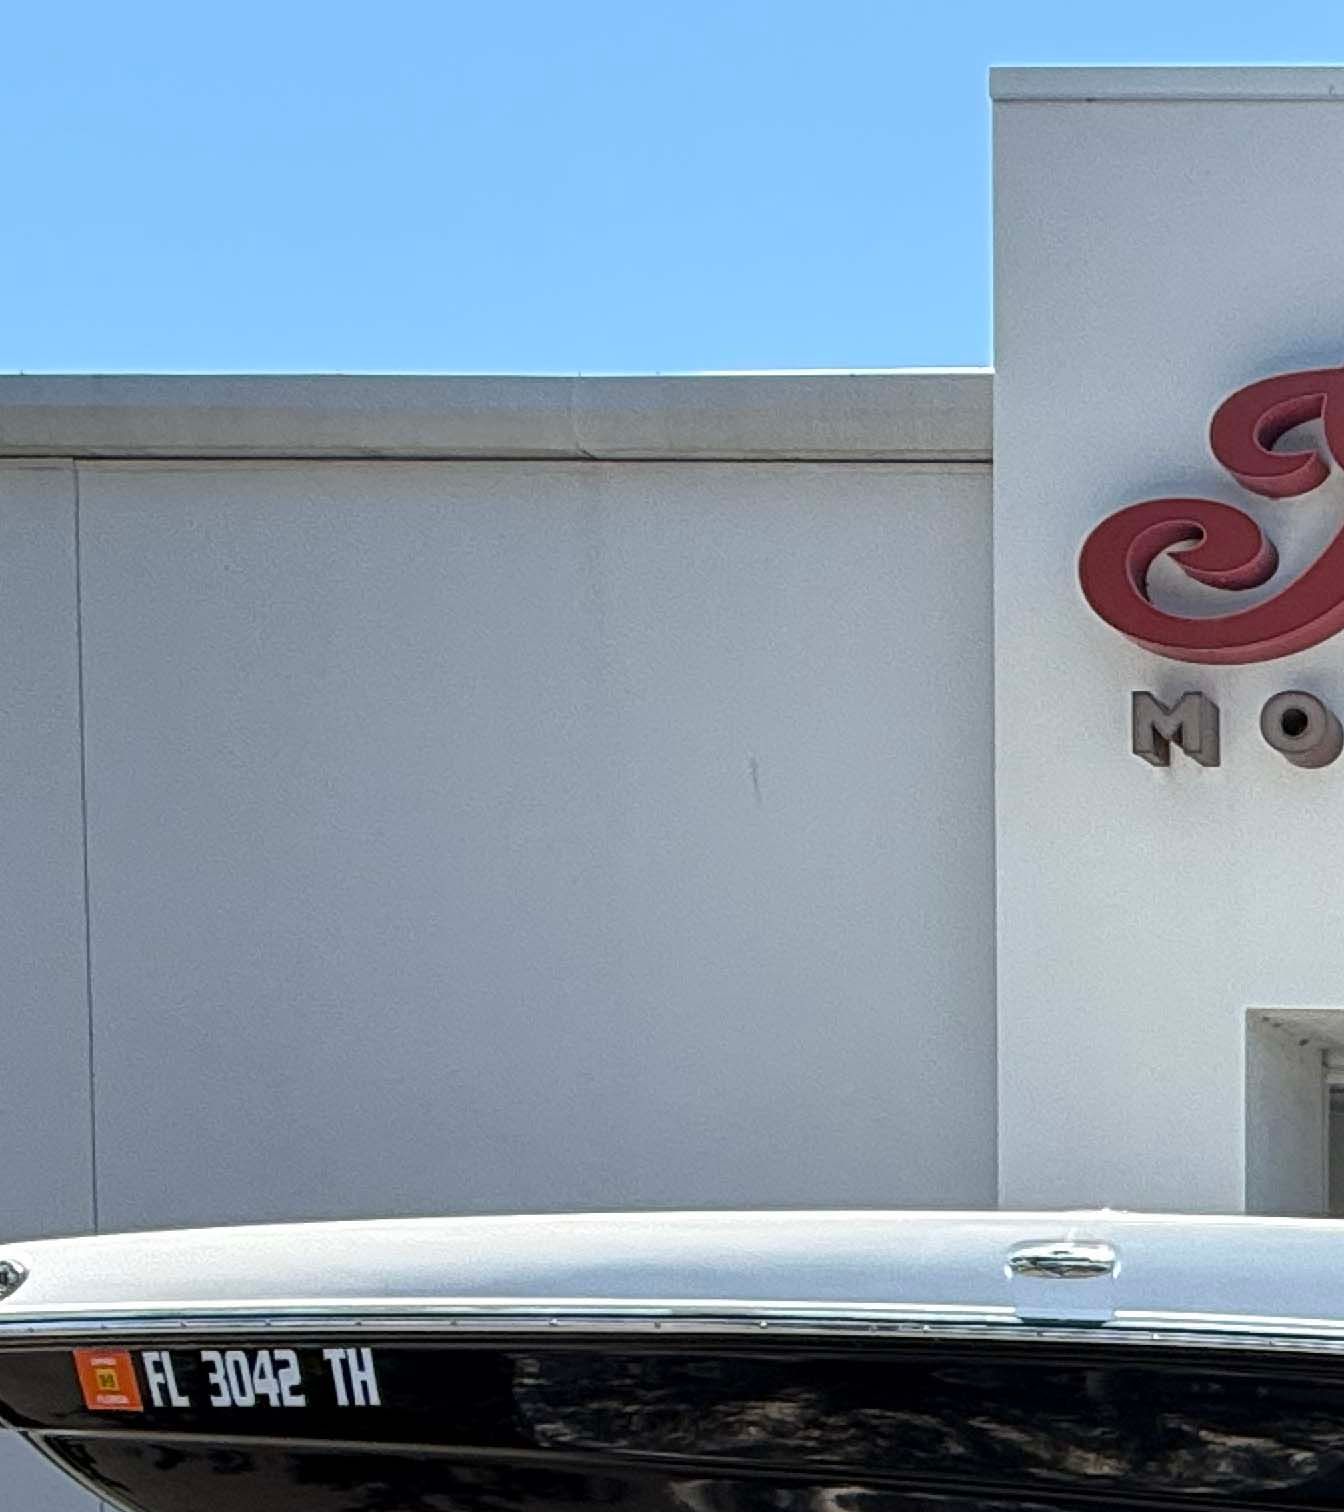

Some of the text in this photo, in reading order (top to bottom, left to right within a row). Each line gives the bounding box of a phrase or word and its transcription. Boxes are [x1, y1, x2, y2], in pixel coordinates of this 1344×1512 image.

[143, 1347, 381, 1407] FL 3042 TH
